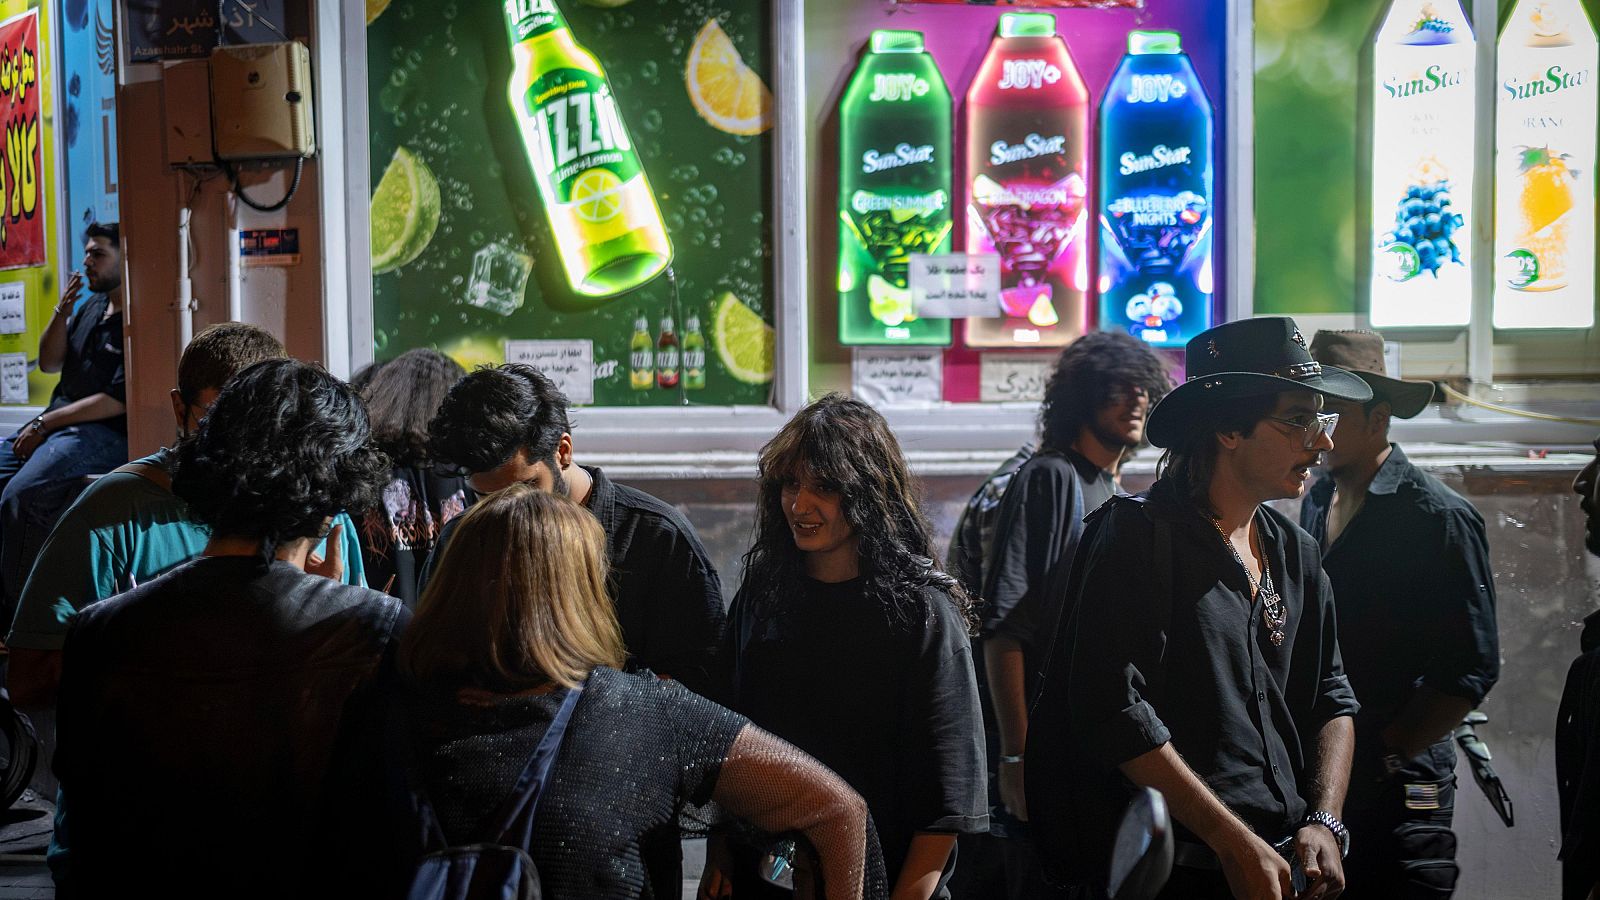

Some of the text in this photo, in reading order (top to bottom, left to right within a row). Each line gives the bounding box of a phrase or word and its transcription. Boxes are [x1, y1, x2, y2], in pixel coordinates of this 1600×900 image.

[862, 143, 934, 173] SunStar
[990, 133, 1066, 165] SunStar
[1119, 144, 1191, 175] SunStar
[1132, 212, 1177, 226] NIGHTS
